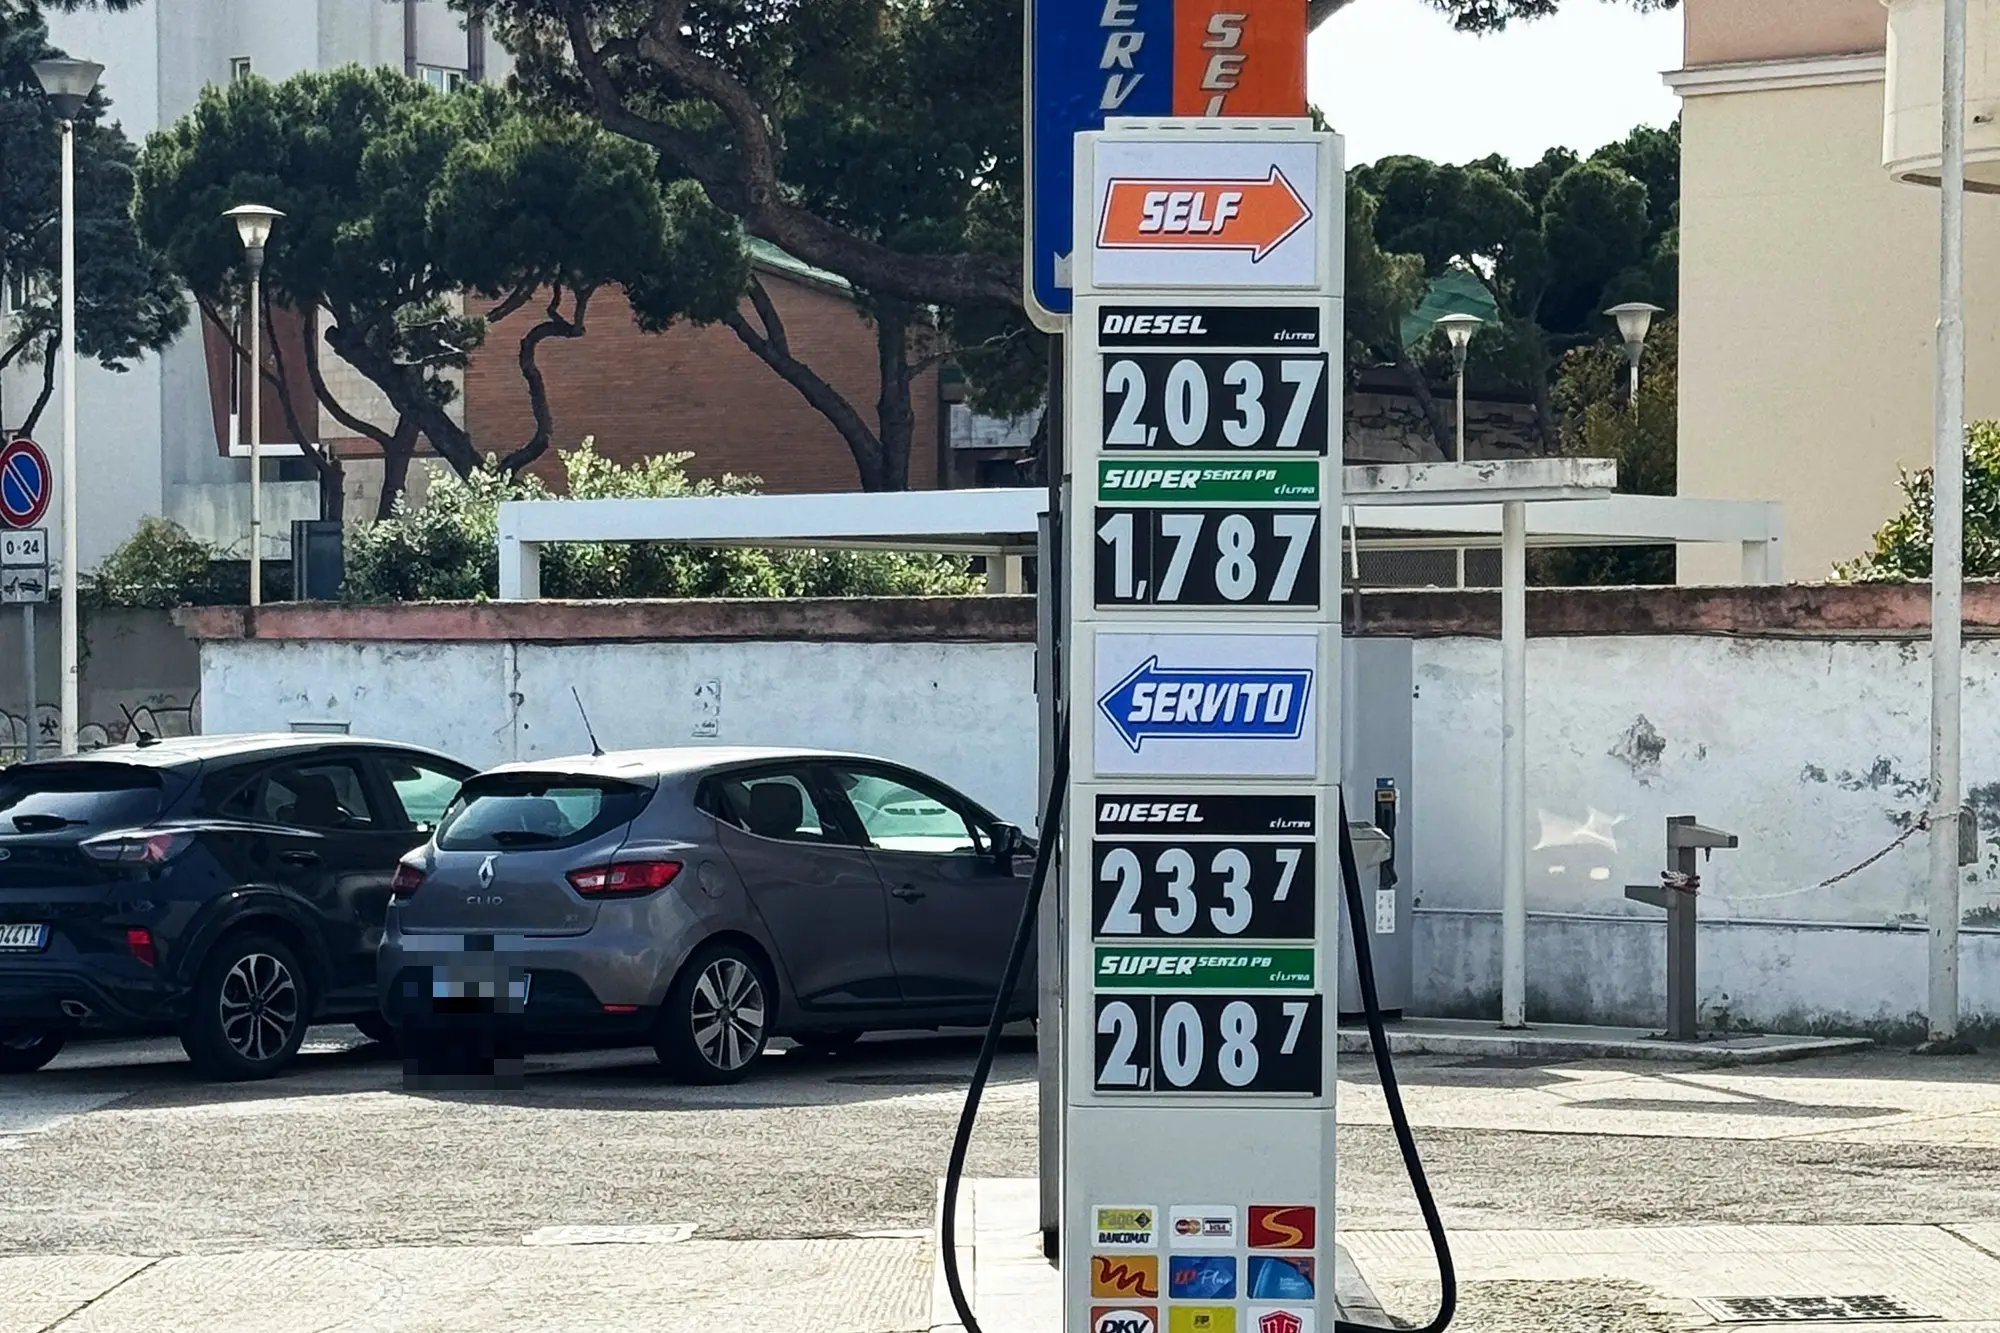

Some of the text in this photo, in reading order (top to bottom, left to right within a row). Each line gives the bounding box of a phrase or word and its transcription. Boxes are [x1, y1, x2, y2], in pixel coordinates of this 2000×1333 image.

[1138, 191, 1243, 234] SELF
[1102, 315, 1208, 334] DIESEL
[1105, 358, 1325, 448] 2,037
[1102, 469, 1277, 489] SUPER SENZA PB
[1096, 513, 1318, 602] 1,787
[1127, 682, 1294, 724] SERVITO
[1099, 803, 1204, 822] DIESEL
[1098, 956, 1273, 975] SUPER SENZA PB
[1097, 1001, 1310, 1088] 2,087
[1098, 1232, 1151, 1244] BANCOMAT
